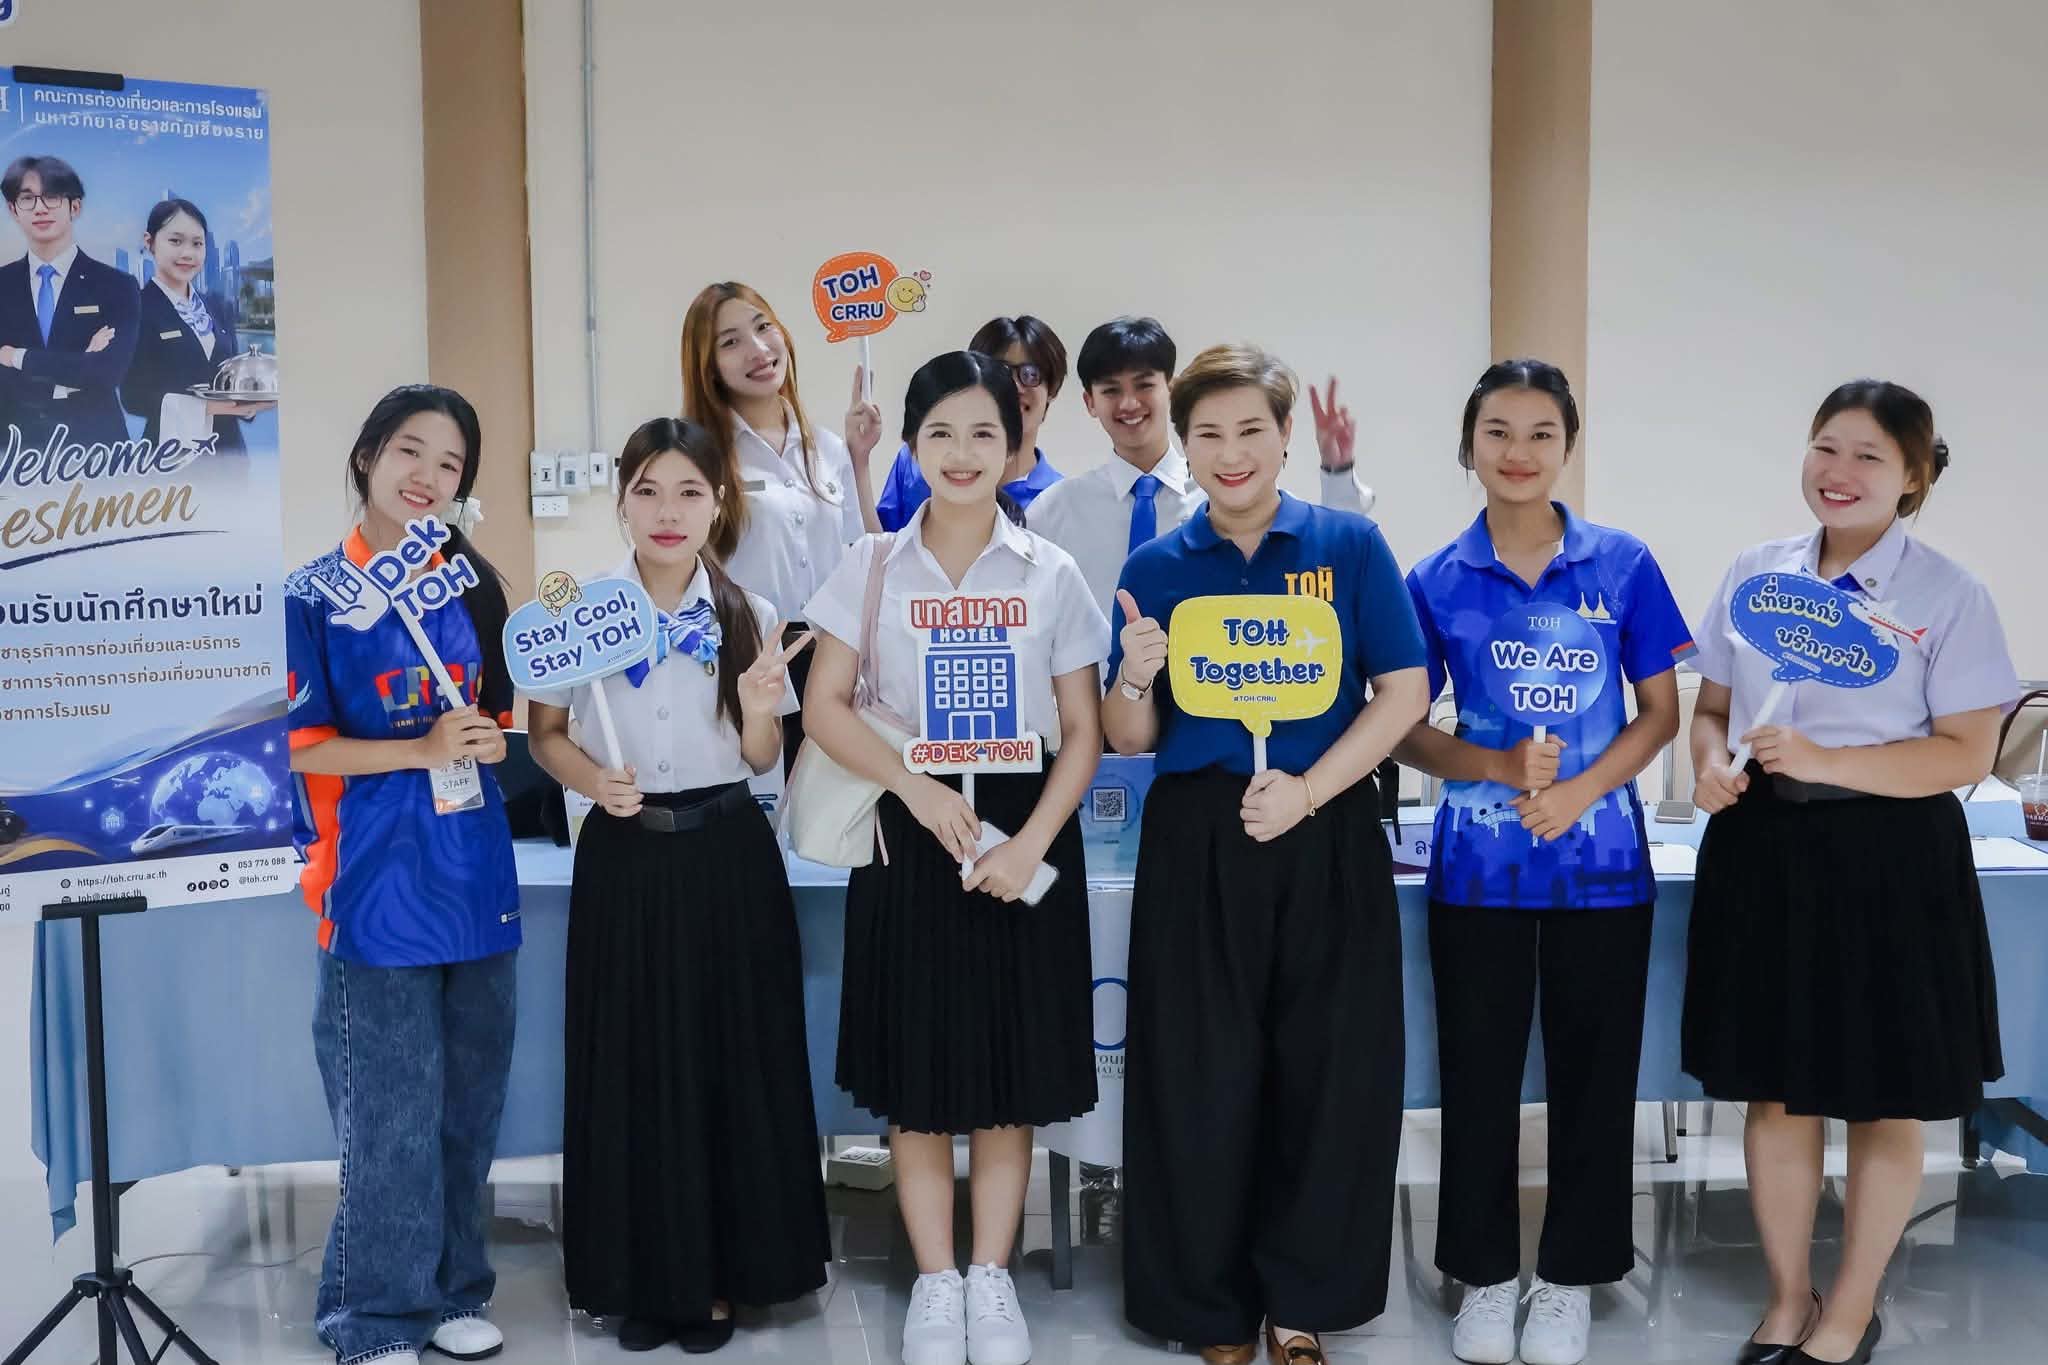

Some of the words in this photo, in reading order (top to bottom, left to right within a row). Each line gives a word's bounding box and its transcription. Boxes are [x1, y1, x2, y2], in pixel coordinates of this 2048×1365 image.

[33, 88, 262, 120] คณะการท่องเที่ยวและการโรงแรม
[35, 110, 264, 140] มหาวิทยาลัยราชภัฏเชียงราย
[823, 265, 879, 299] TOH
[831, 302, 884, 320] CRRU
[368, 519, 447, 591] Dek
[393, 557, 476, 617] TOH
[1284, 566, 1333, 601] TOH
[1749, 575, 1842, 624] เที่ยวเก่ง
[515, 619, 568, 654] Stay
[573, 589, 636, 627] Cool,
[939, 628, 999, 642] HOTEL
[1223, 618, 1289, 646] TOH
[1527, 616, 1561, 629] TOH
[529, 644, 582, 678] Stay
[586, 615, 642, 653] TOH
[1492, 642, 1538, 668] We
[1545, 644, 1596, 670] Are
[1776, 626, 1874, 673] บริการปัง
[1189, 655, 1326, 692] Together
[0, 702, 110, 721] ชาการโรงแรม
[1513, 685, 1575, 710] TOH
[983, 741, 1034, 762] TOH
[77, 870, 167, 887] https://toh.crru.ac.th
